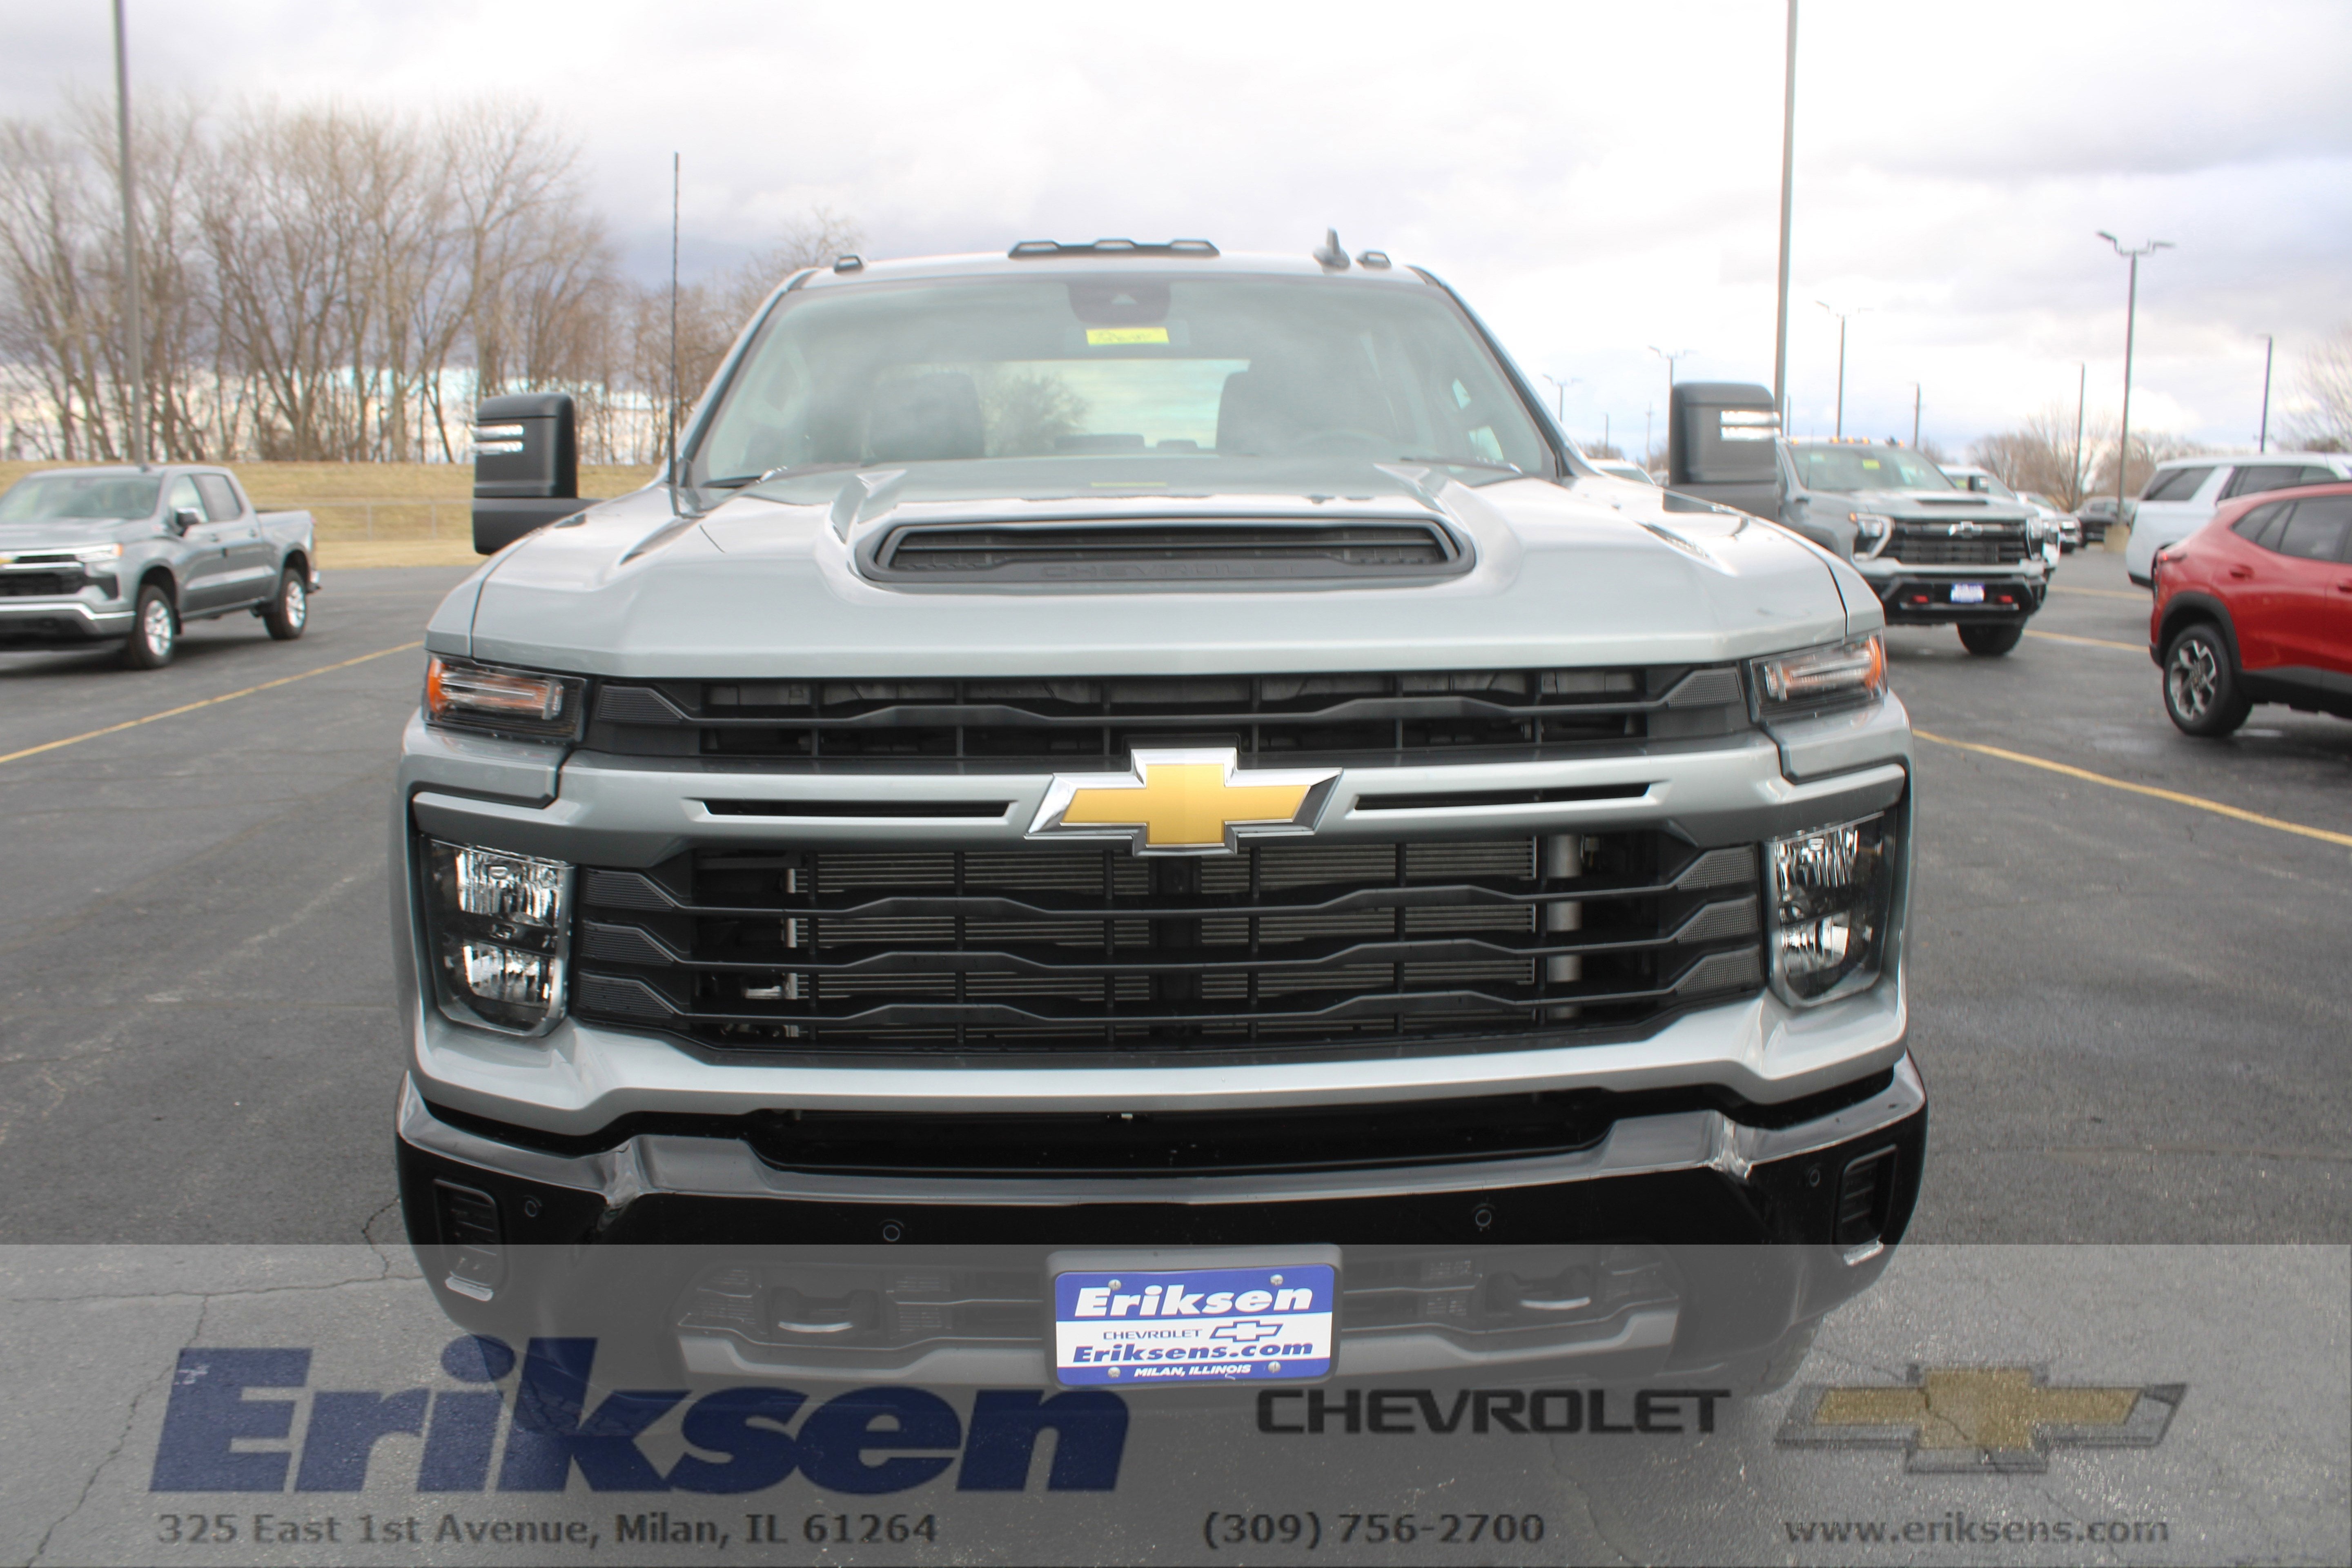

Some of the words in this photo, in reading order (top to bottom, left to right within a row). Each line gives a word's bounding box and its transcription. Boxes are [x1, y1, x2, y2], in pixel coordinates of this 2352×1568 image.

[1074, 1285, 1313, 1317] Eriksen
[1103, 1329, 1203, 1341] CHEVROLET
[1073, 1342, 1313, 1363] Eriksens.com
[1134, 1366, 1186, 1378] MILAN,
[1189, 1364, 1252, 1376] ILLINOIS
